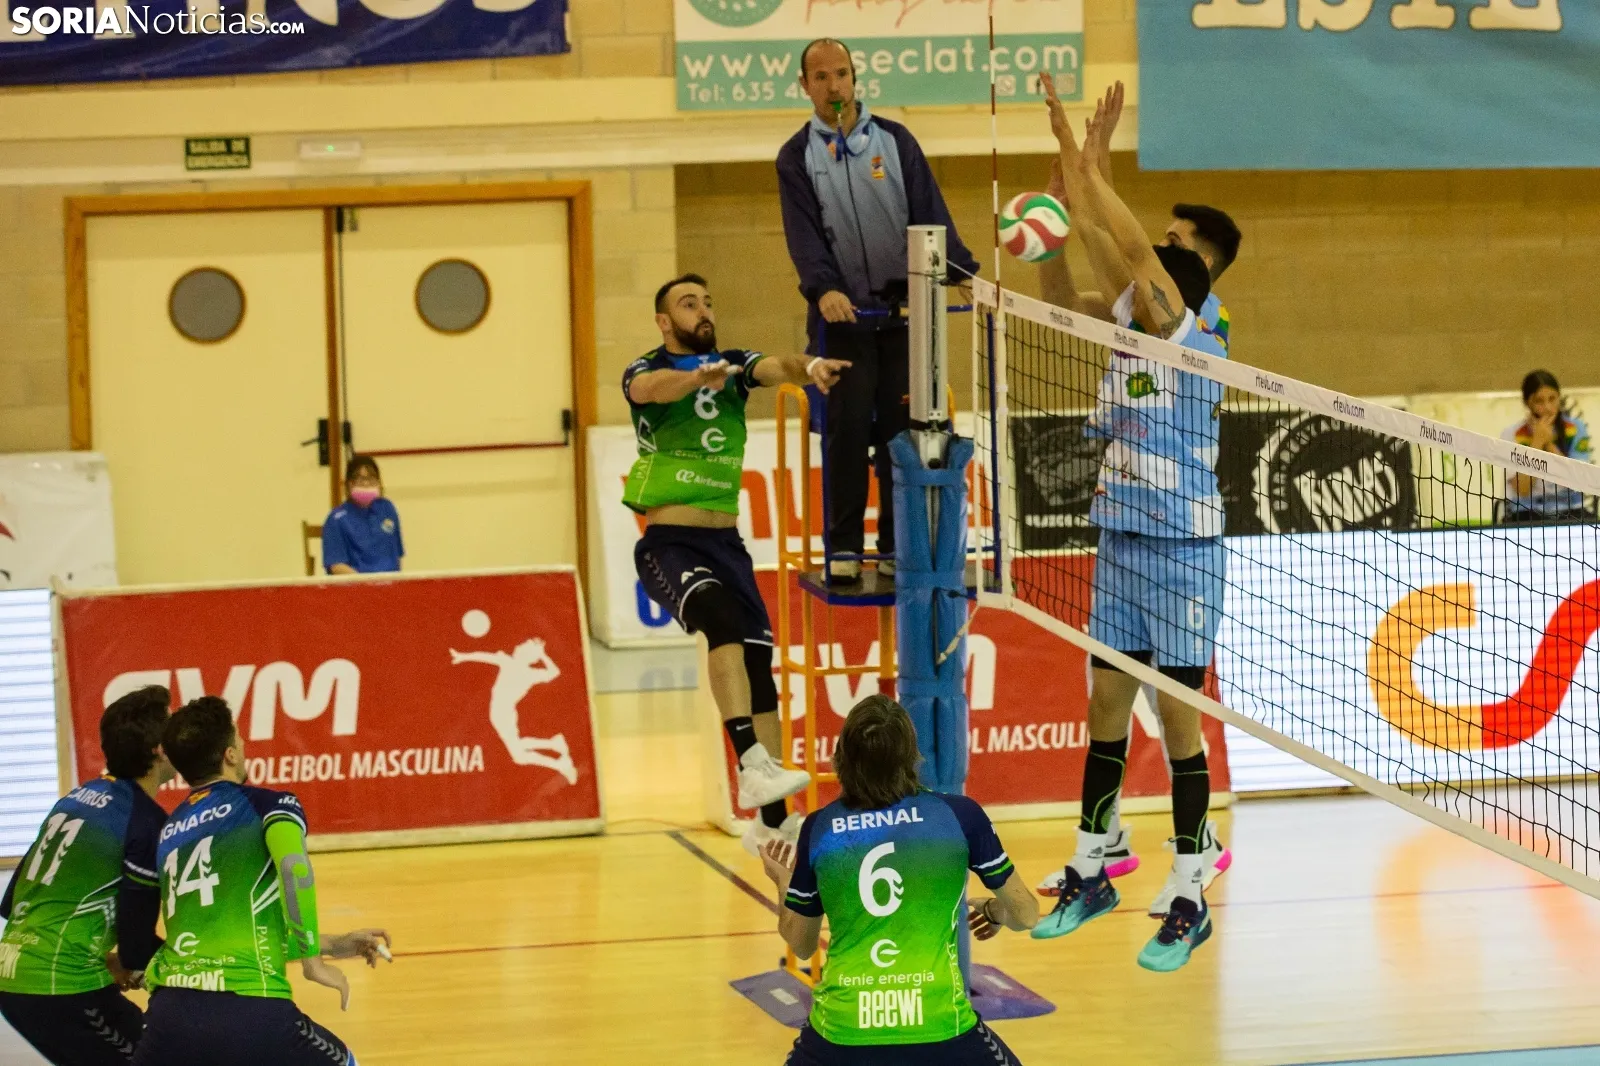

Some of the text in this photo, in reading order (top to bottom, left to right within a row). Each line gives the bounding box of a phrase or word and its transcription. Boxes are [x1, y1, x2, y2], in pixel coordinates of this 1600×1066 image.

[687, 83, 725, 103] Tel:
[732, 81, 775, 102] 635
[987, 721, 1091, 753] MASCULI
[350, 745, 485, 780] MASCULINA
[159, 803, 232, 844] IGNACIO
[831, 807, 924, 834] BERNAL
[26, 812, 85, 886] 11
[163, 835, 220, 919] 14
[858, 841, 904, 917] 6
